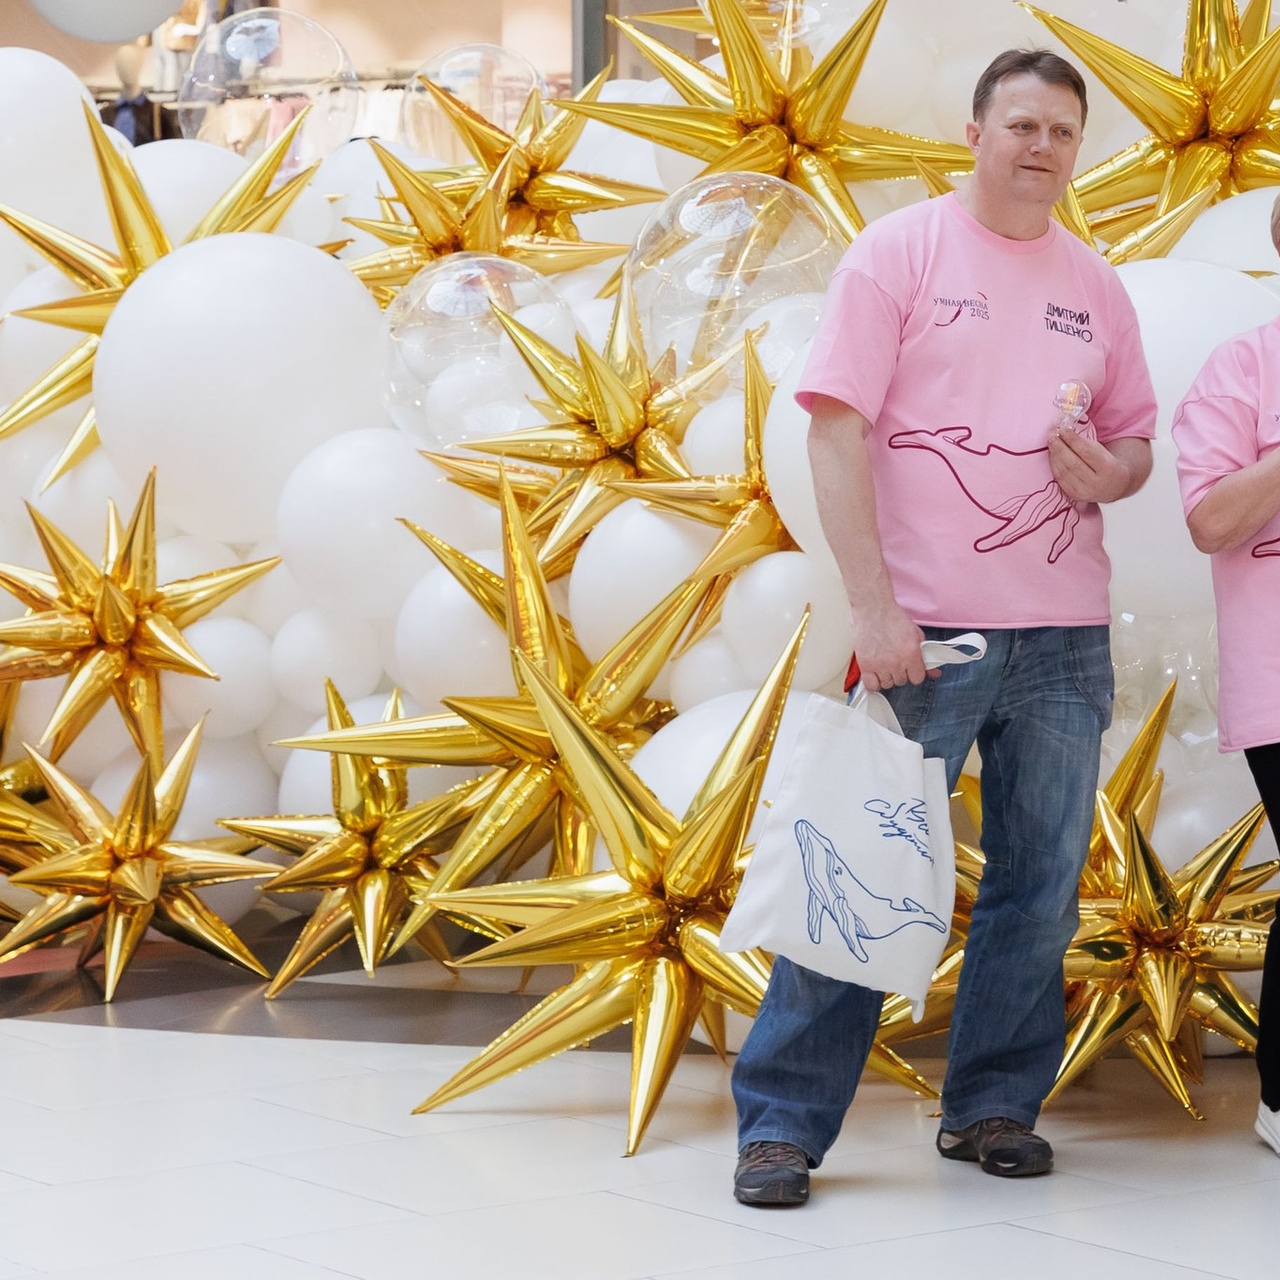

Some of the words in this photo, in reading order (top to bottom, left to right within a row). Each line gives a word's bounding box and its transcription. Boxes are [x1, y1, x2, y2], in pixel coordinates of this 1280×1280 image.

[933, 297, 962, 307] УМНАЯ
[963, 298, 989, 310] ВЕСНА
[970, 307, 990, 320] 2025
[1046, 302, 1090, 326] ДМИТРИЙ
[1044, 317, 1093, 343] ТИЩЕНКО
